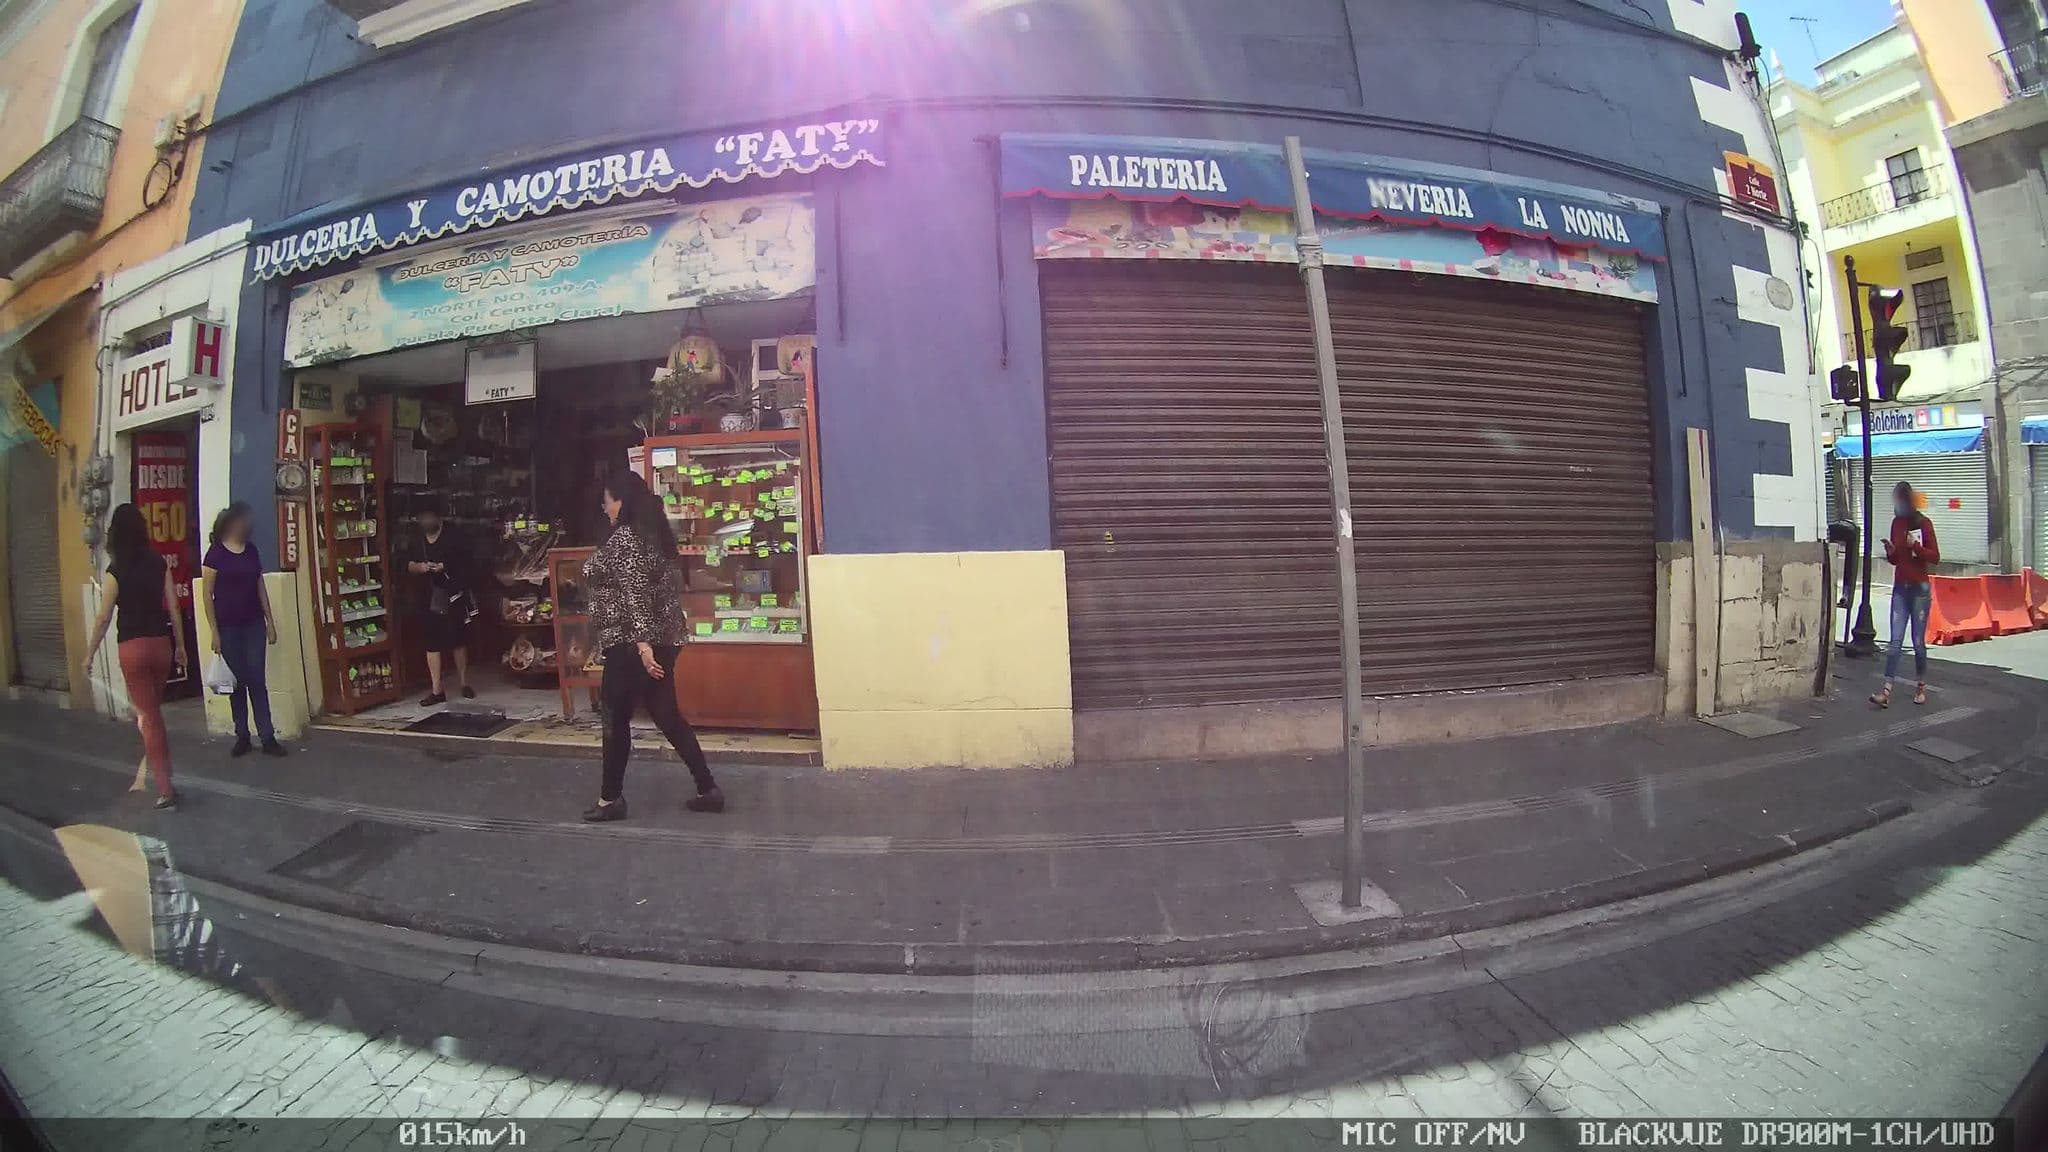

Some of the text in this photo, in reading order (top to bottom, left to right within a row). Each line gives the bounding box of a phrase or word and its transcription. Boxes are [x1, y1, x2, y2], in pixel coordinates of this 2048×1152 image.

[1068, 154, 1228, 193] PALETERIA
[254, 212, 378, 272] DULCERIA
[407, 199, 428, 229] Y
[455, 147, 674, 217] CAMOTERIA
[1366, 176, 1632, 244] NEVERIA LA NONNA
[494, 248, 509, 260] Y
[511, 225, 649, 257] CAMOTERÍA
[424, 299, 485, 317] NORTE
[450, 302, 556, 323] Col. Centro
[193, 323, 222, 378] H
[1868, 408, 1914, 432] Bolchima
[138, 464, 187, 489] DESDE
